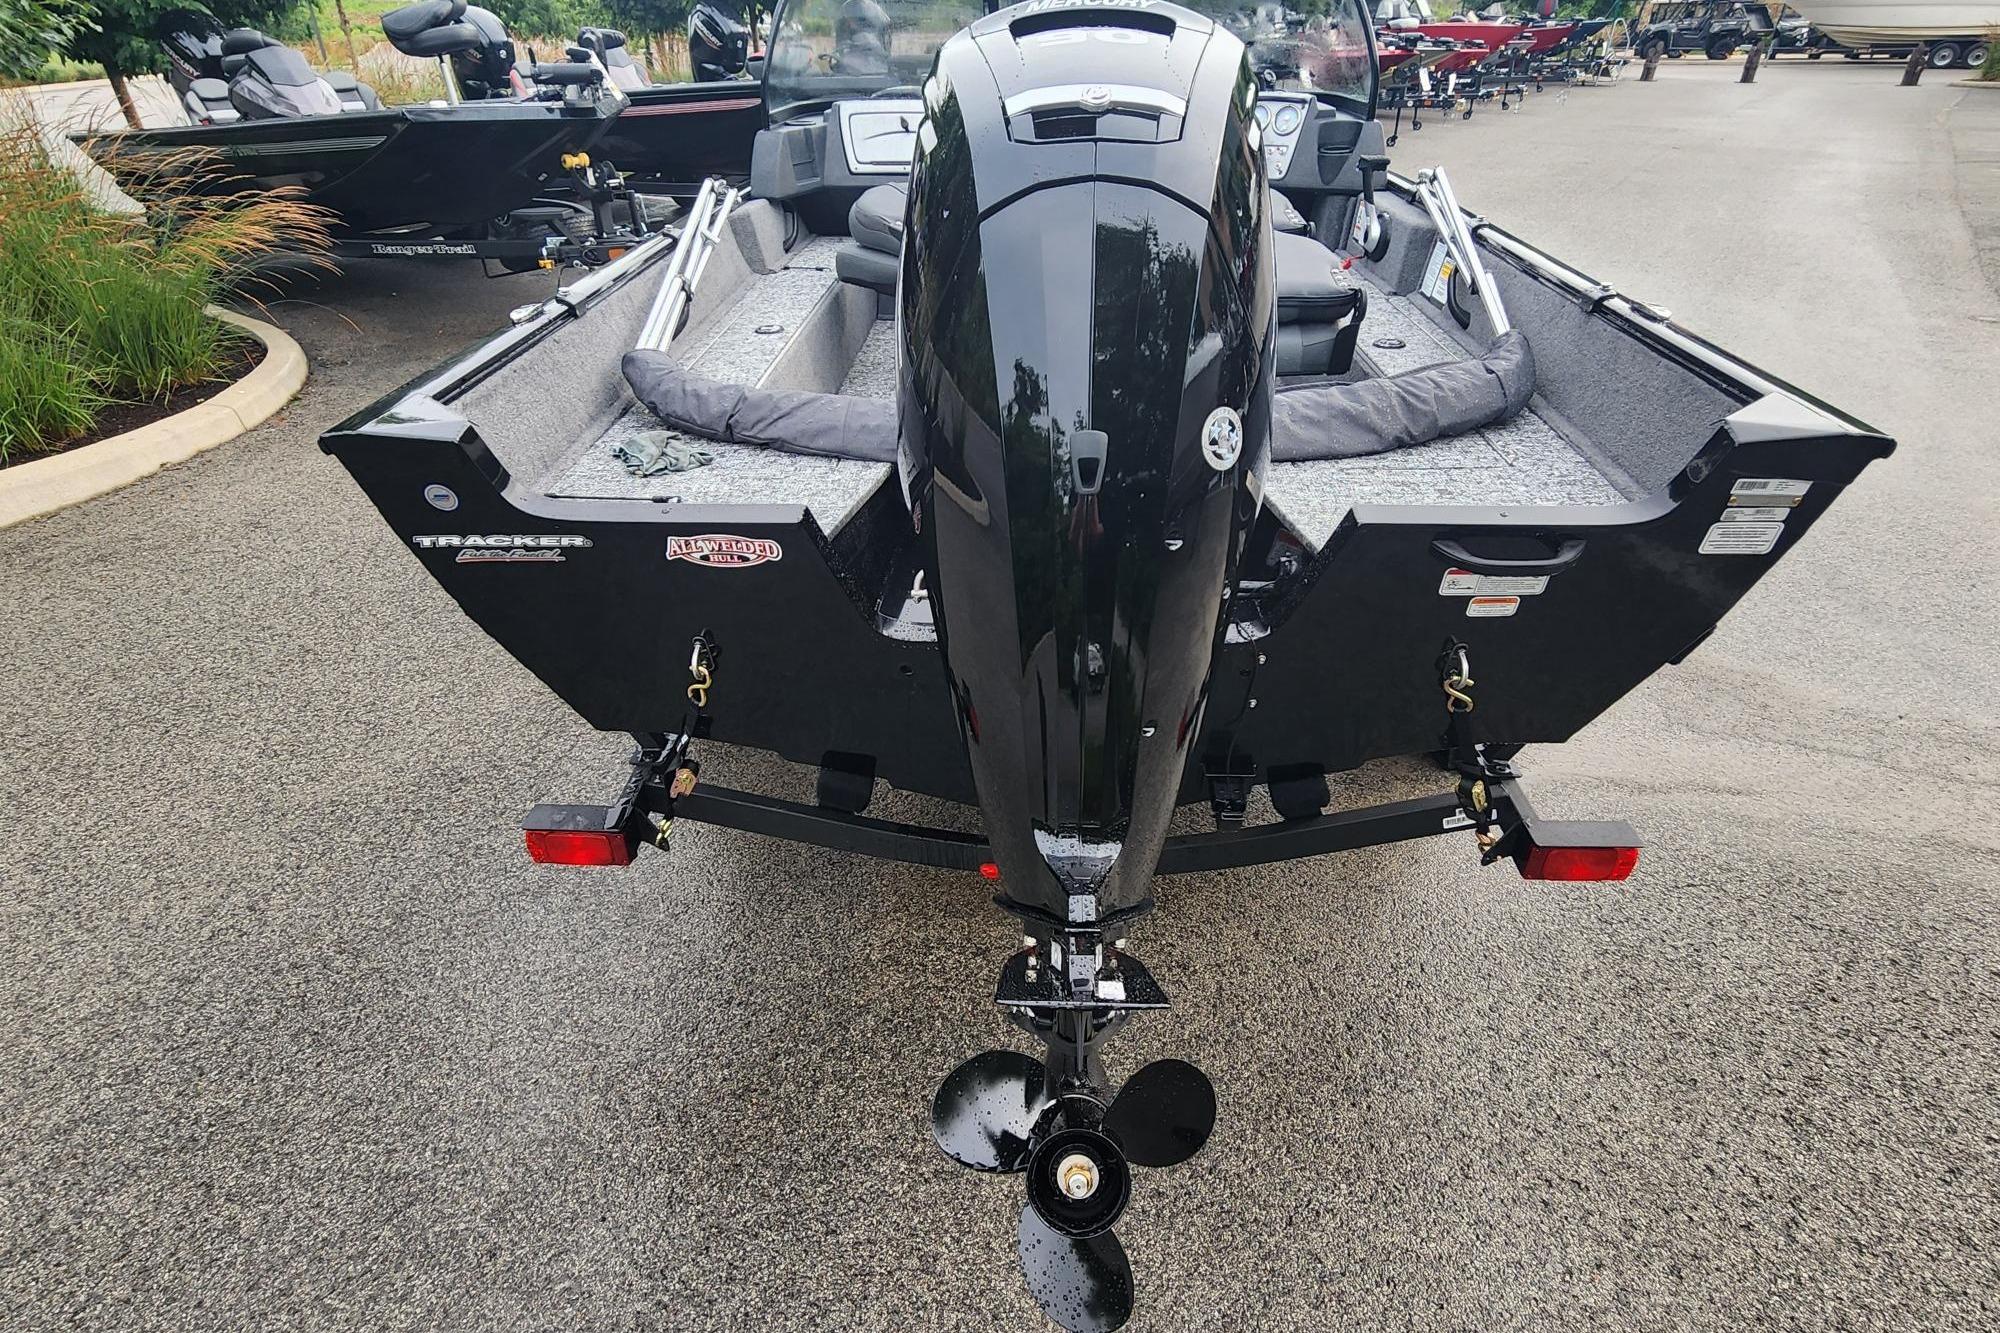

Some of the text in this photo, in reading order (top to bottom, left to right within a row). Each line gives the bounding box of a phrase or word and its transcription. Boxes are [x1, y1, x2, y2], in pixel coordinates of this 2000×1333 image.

[371, 243, 476, 256] Ranger Trail
[669, 538, 779, 559] ALL WELDED
[708, 554, 742, 563] HULL
